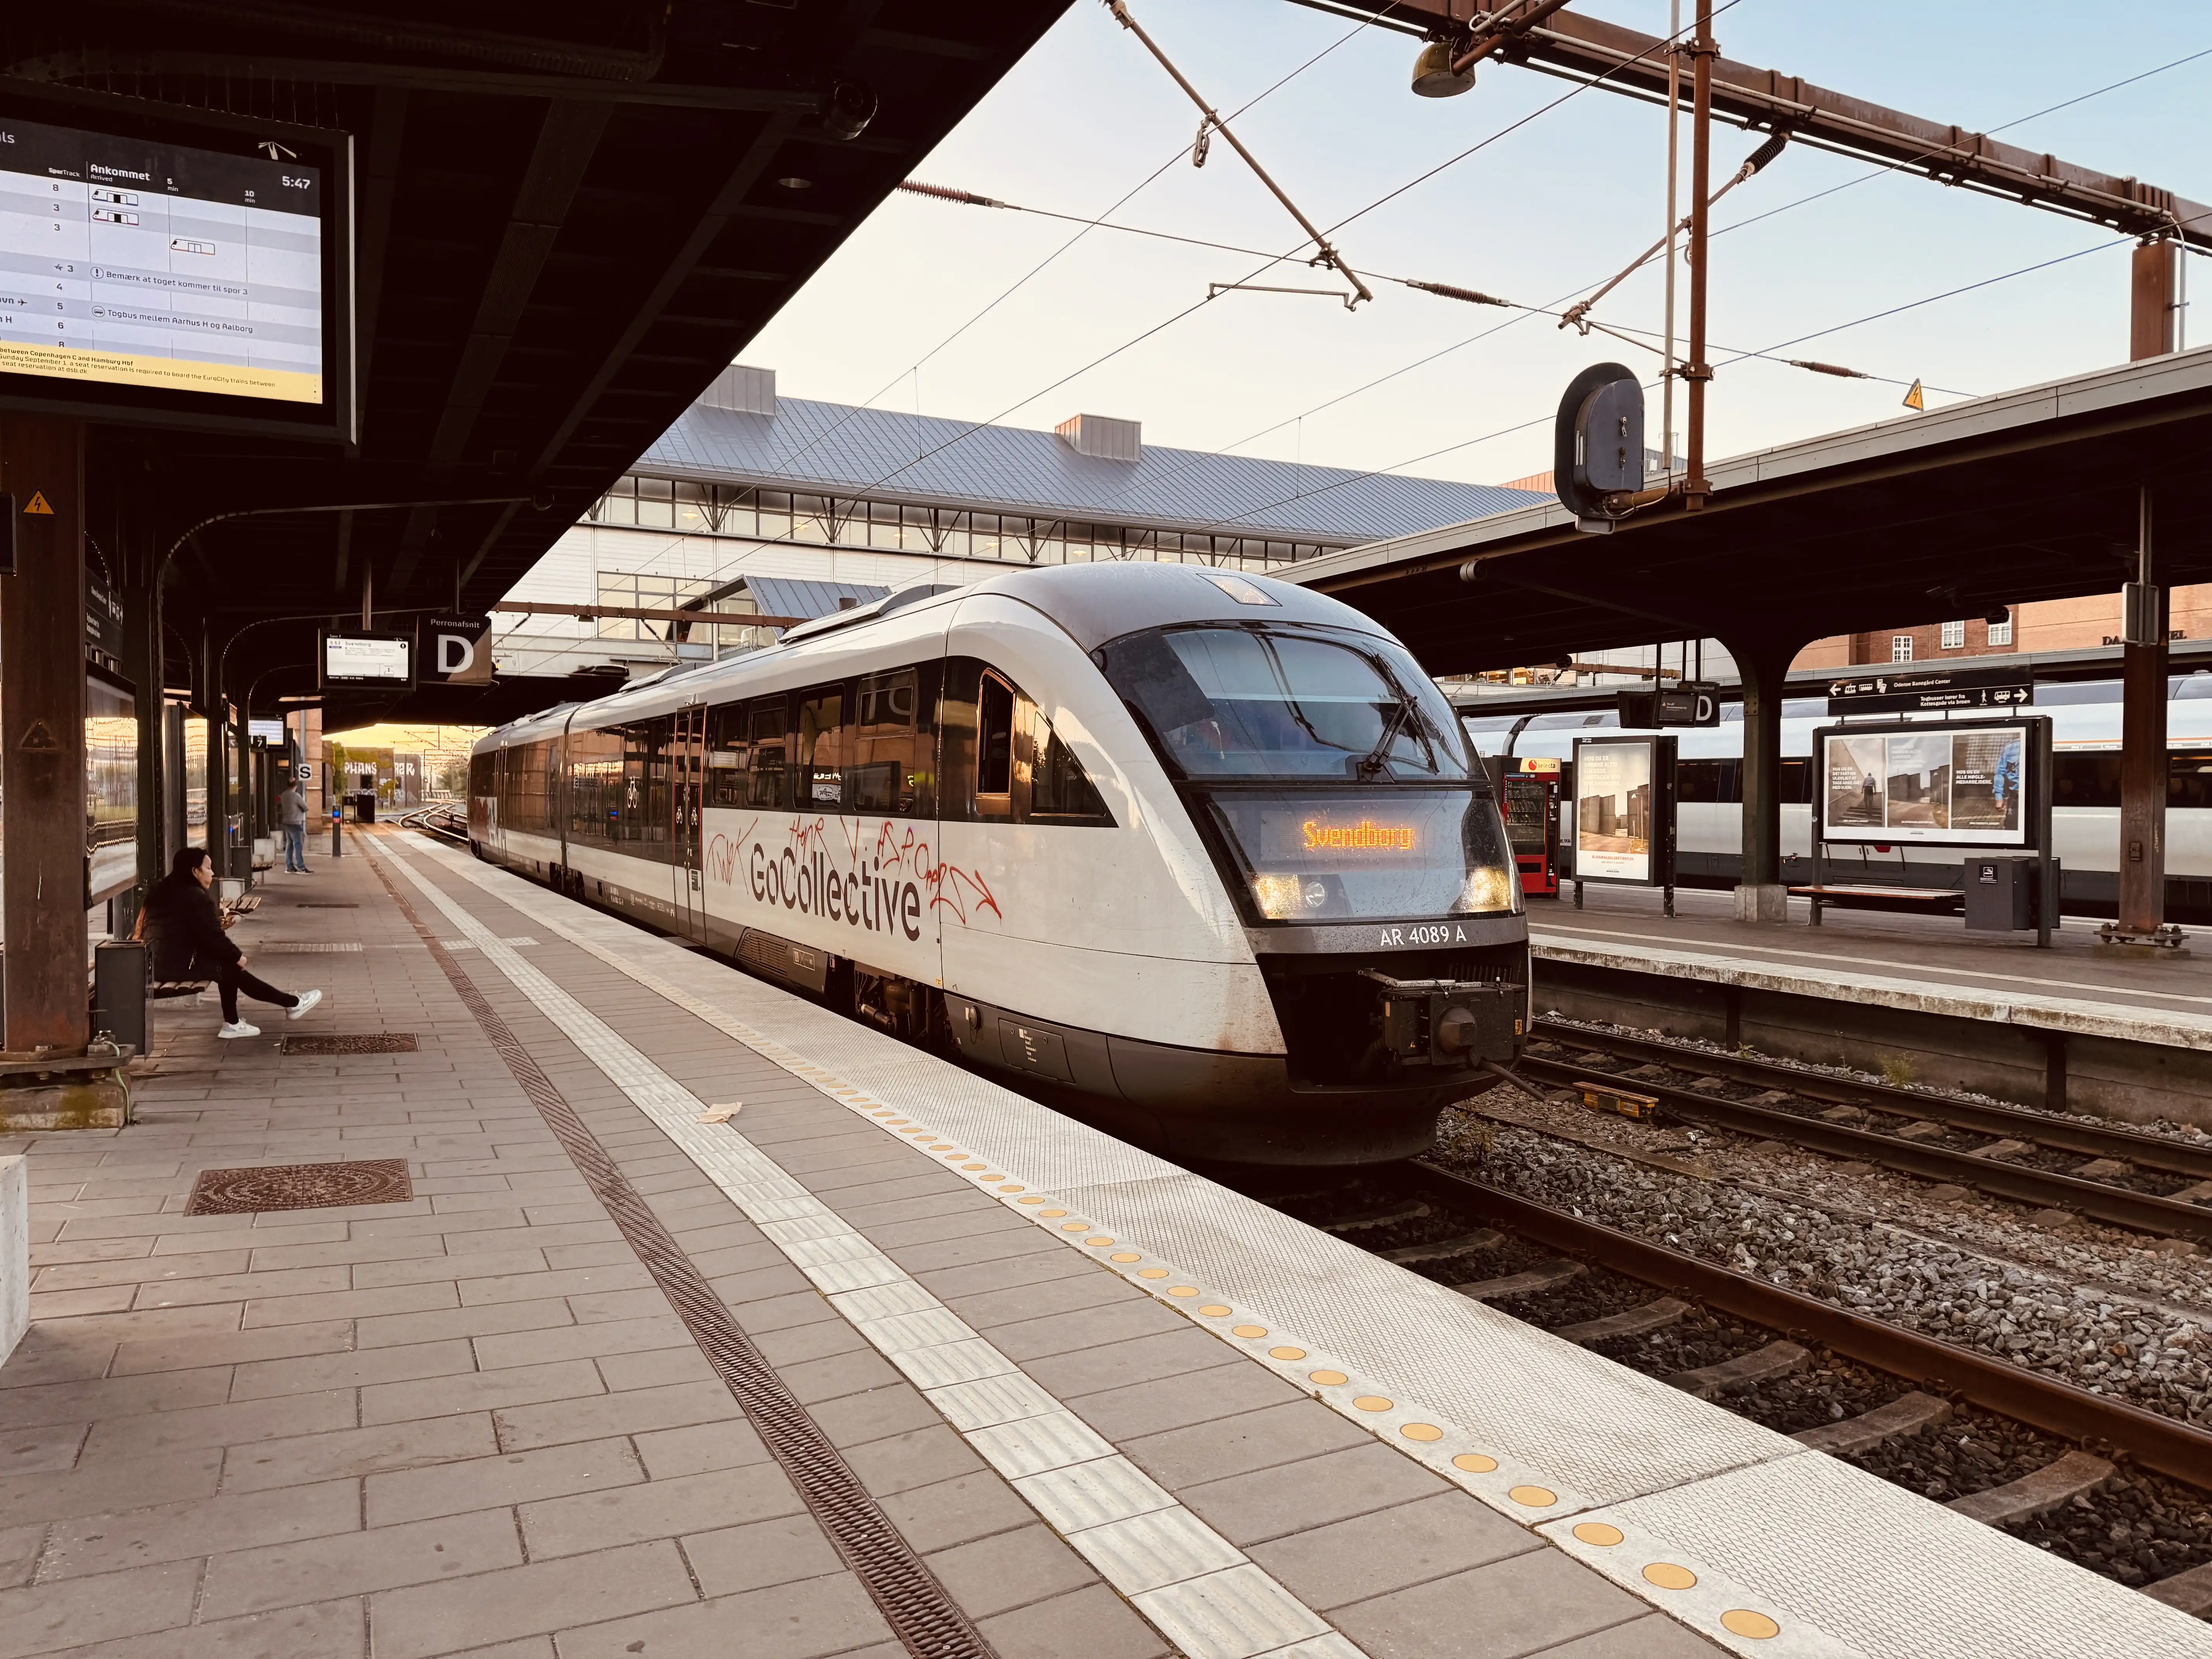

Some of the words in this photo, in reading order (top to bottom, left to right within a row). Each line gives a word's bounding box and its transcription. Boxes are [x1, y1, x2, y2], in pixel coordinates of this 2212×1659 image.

[0, 131, 15, 144] ls
[90, 163, 150, 181] Ankommet
[90, 174, 113, 182] Arrived
[282, 175, 311, 189] 5:47
[106, 271, 141, 282] Bemærk
[153, 277, 176, 286] toget
[178, 280, 211, 290] kommer
[108, 309, 137, 319] Togbus
[139, 314, 170, 323] mellem
[172, 318, 201, 326] Aarhus
[222, 323, 253, 333] Aalborg
[0, 347, 28, 355] between
[30, 350, 71, 360] Copenhagen
[91, 357, 120, 365] Hamburg
[0, 354, 23, 362] Sunday
[25, 356, 61, 365] September
[91, 364, 127, 372] reservation
[203, 375, 229, 383] EuroCity
[18, 363, 56, 371] reservation
[430, 618, 480, 629] Perronafsnit
[438, 634, 474, 673] D
[1696, 695, 1712, 721] D
[299, 766, 311, 779] S
[1302, 819, 1415, 850] Svendborg
[750, 842, 920, 942] GoCollective
[1380, 928, 1405, 947] AR
[1408, 926, 1449, 944] 4089
[1456, 925, 1467, 943] A
